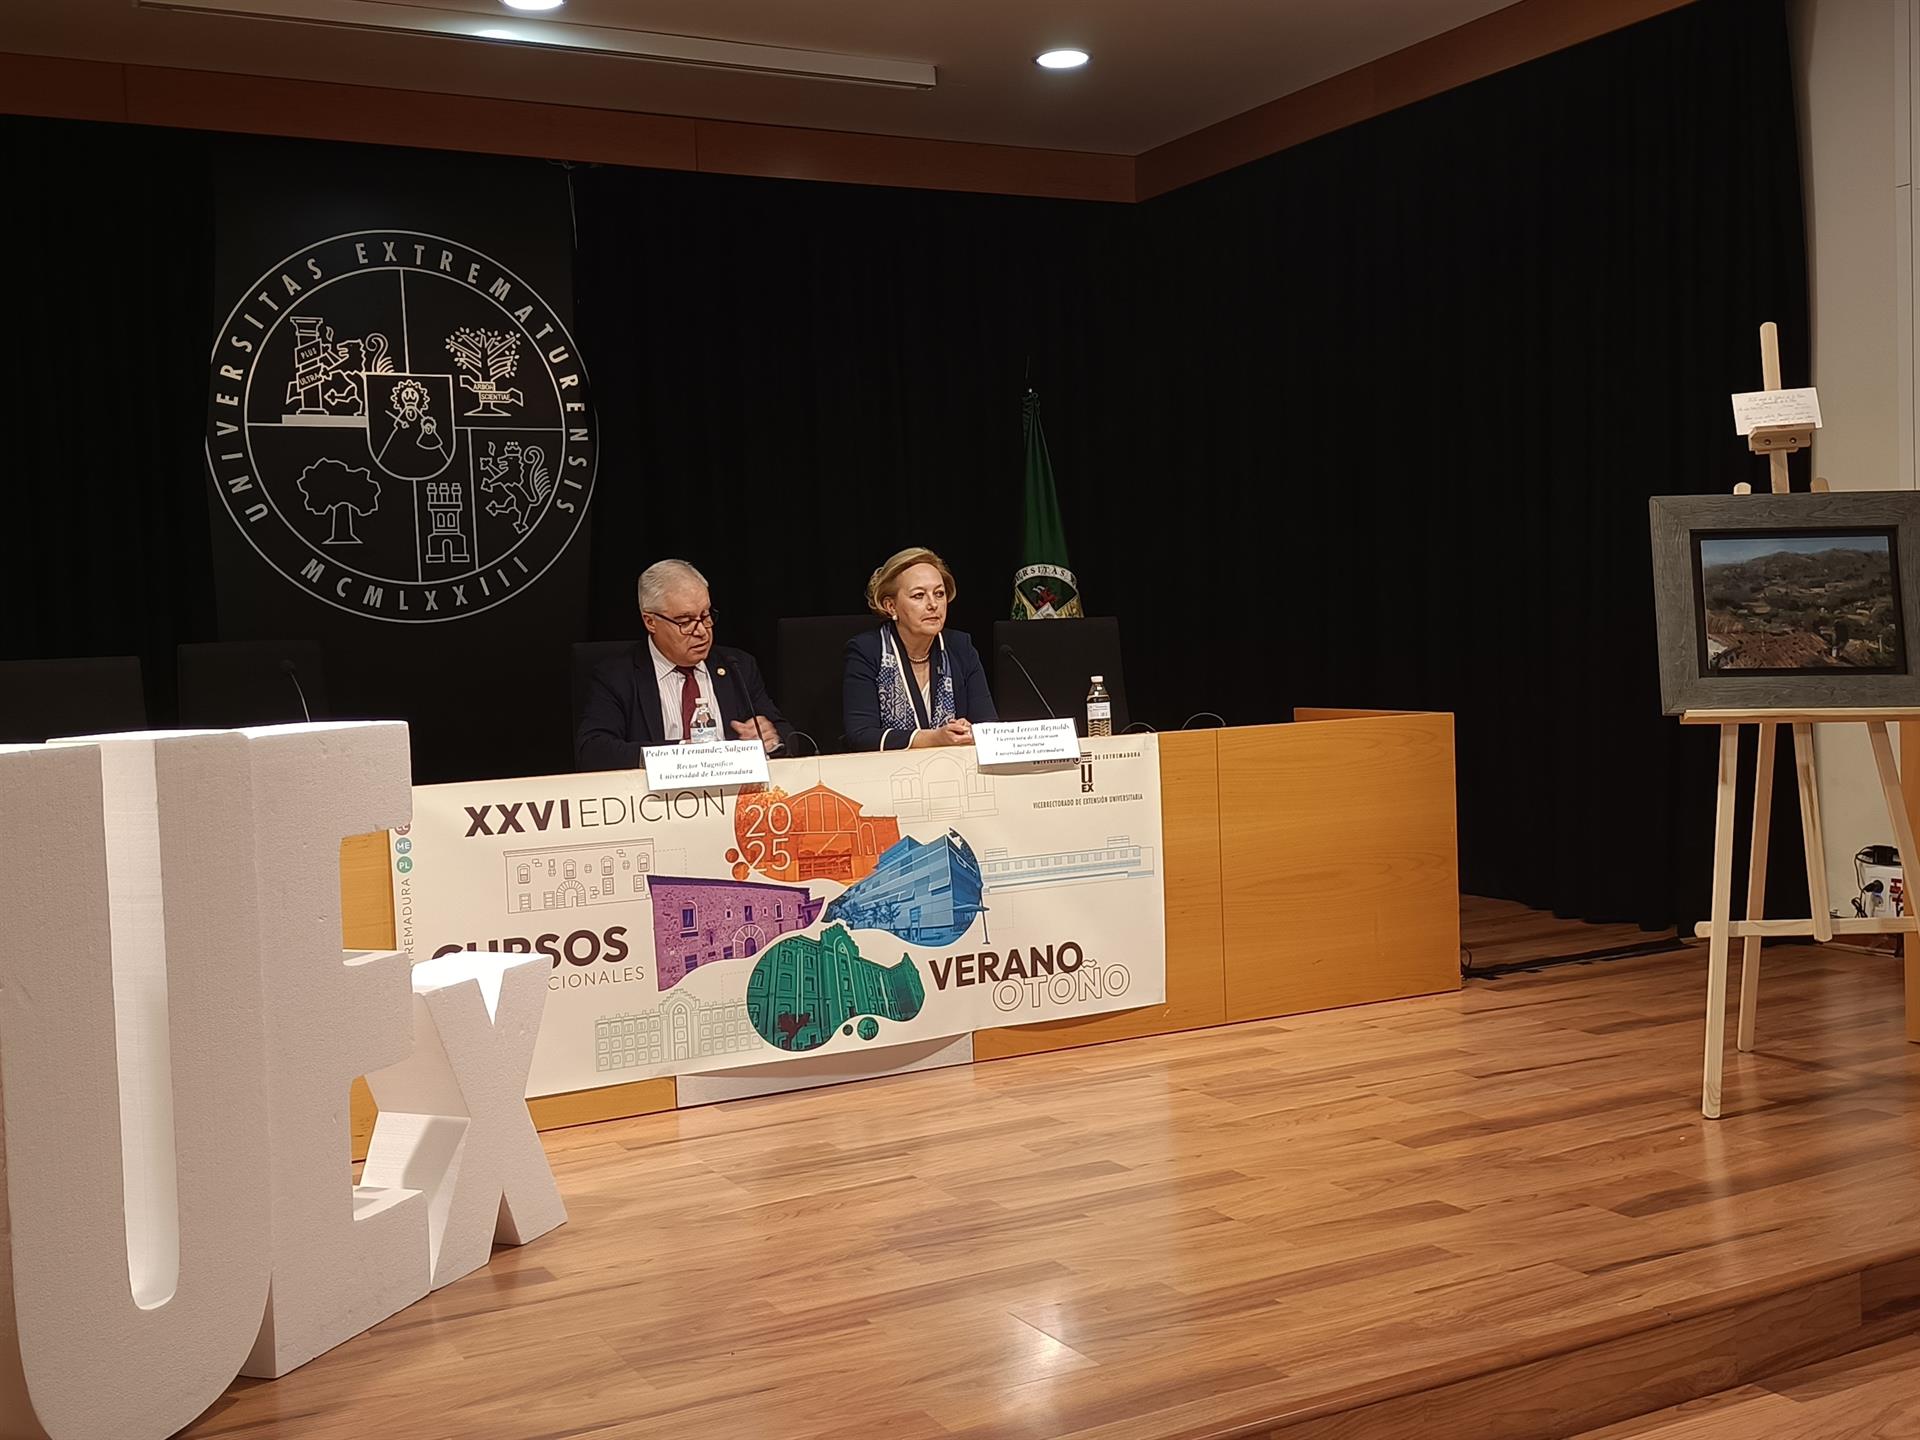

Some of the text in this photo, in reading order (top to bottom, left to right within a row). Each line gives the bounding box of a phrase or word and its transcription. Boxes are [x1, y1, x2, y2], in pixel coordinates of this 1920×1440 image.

[300, 347, 317, 360] PLUS
[216, 241, 589, 522] UNIVERSITAS EXTREMATURENSIS
[300, 556, 529, 612] MCMLXXIII
[1041, 723, 1070, 732] Reynolds
[645, 750, 669, 758] Pedro
[724, 745, 759, 754] Salguero
[660, 768, 753, 780] Universidad de Extremadura
[1033, 799, 1075, 809] VICERRECTORADO
[1075, 798, 1082, 806] DE
[1109, 793, 1143, 803] UNIVERSITARIA
[464, 799, 571, 837] XXVI
[744, 801, 792, 838] 20
[396, 841, 411, 850] ME
[746, 837, 791, 873] 25
[399, 861, 411, 870] PL
[547, 966, 645, 991] CIONALES
[928, 941, 1084, 991] VERANO
[992, 958, 1131, 1012] OTOÑO
